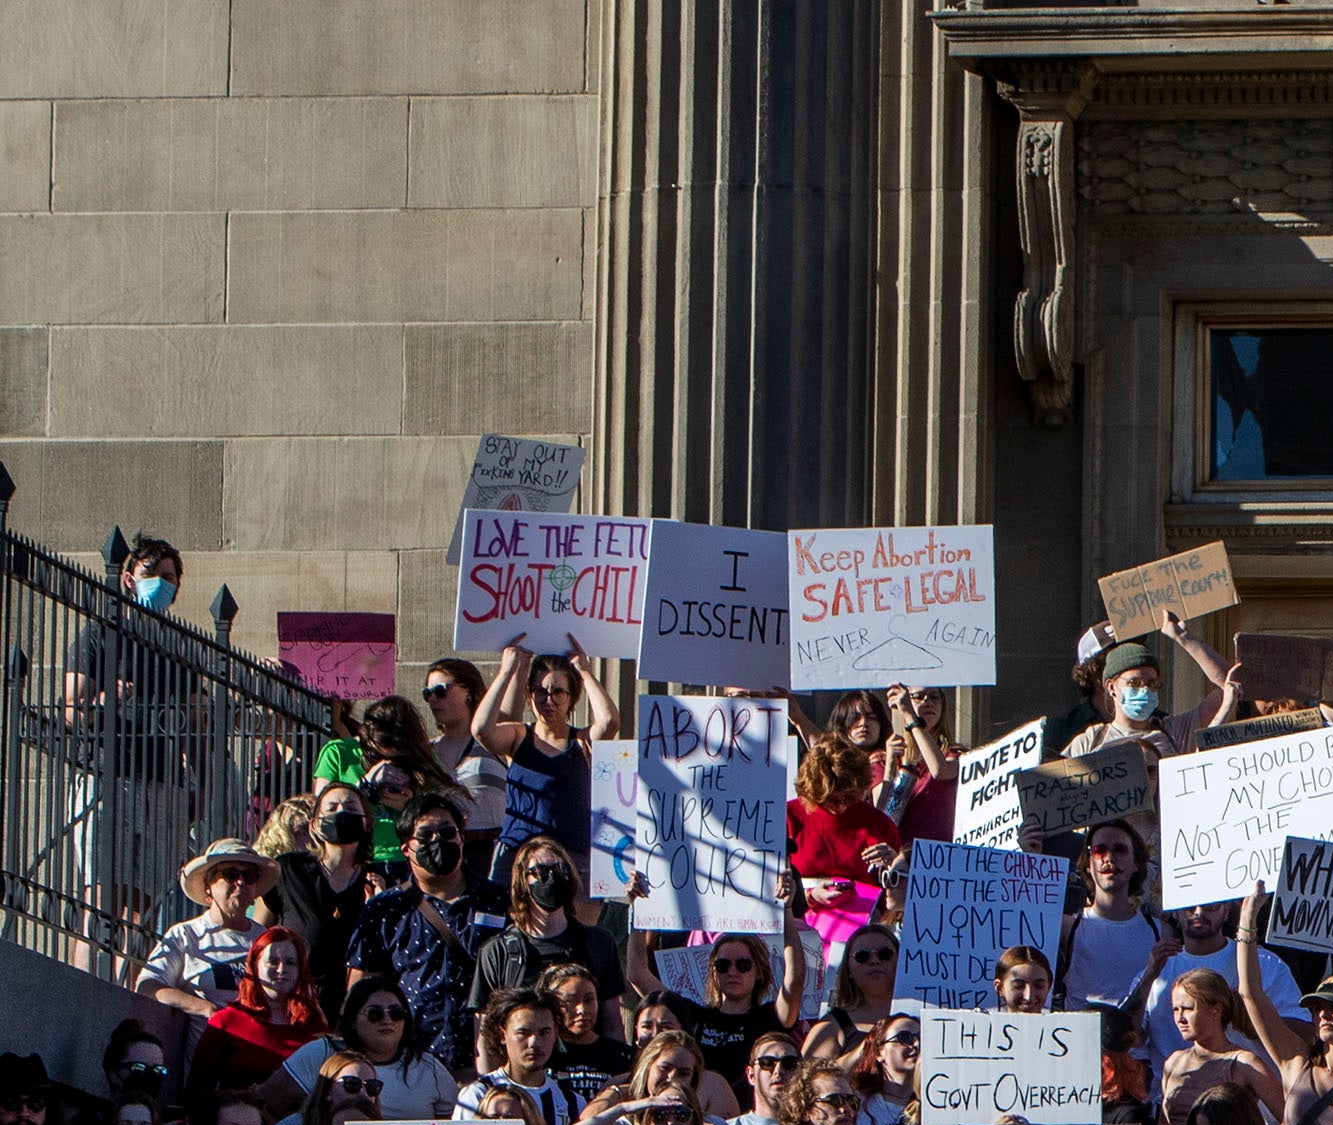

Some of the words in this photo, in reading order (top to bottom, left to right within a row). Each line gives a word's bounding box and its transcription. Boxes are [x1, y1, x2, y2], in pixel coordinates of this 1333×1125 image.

[538, 525, 584, 558] THE
[795, 533, 865, 575] Keep
[871, 531, 972, 569] Abortion
[722, 550, 749, 592] I
[801, 577, 894, 623] SAFE
[904, 569, 987, 613] LEGAL
[796, 627, 870, 664] NEVER
[643, 707, 783, 767] ABORT
[689, 764, 728, 791] THE
[1176, 766, 1209, 798] IT
[1226, 743, 1315, 782] SHOULD
[645, 799, 775, 843] SUPREME
[1241, 807, 1292, 841] THE
[1001, 880, 1059, 904] STATE
[932, 1018, 1020, 1054] THIS
[1039, 1027, 1071, 1057] IS
